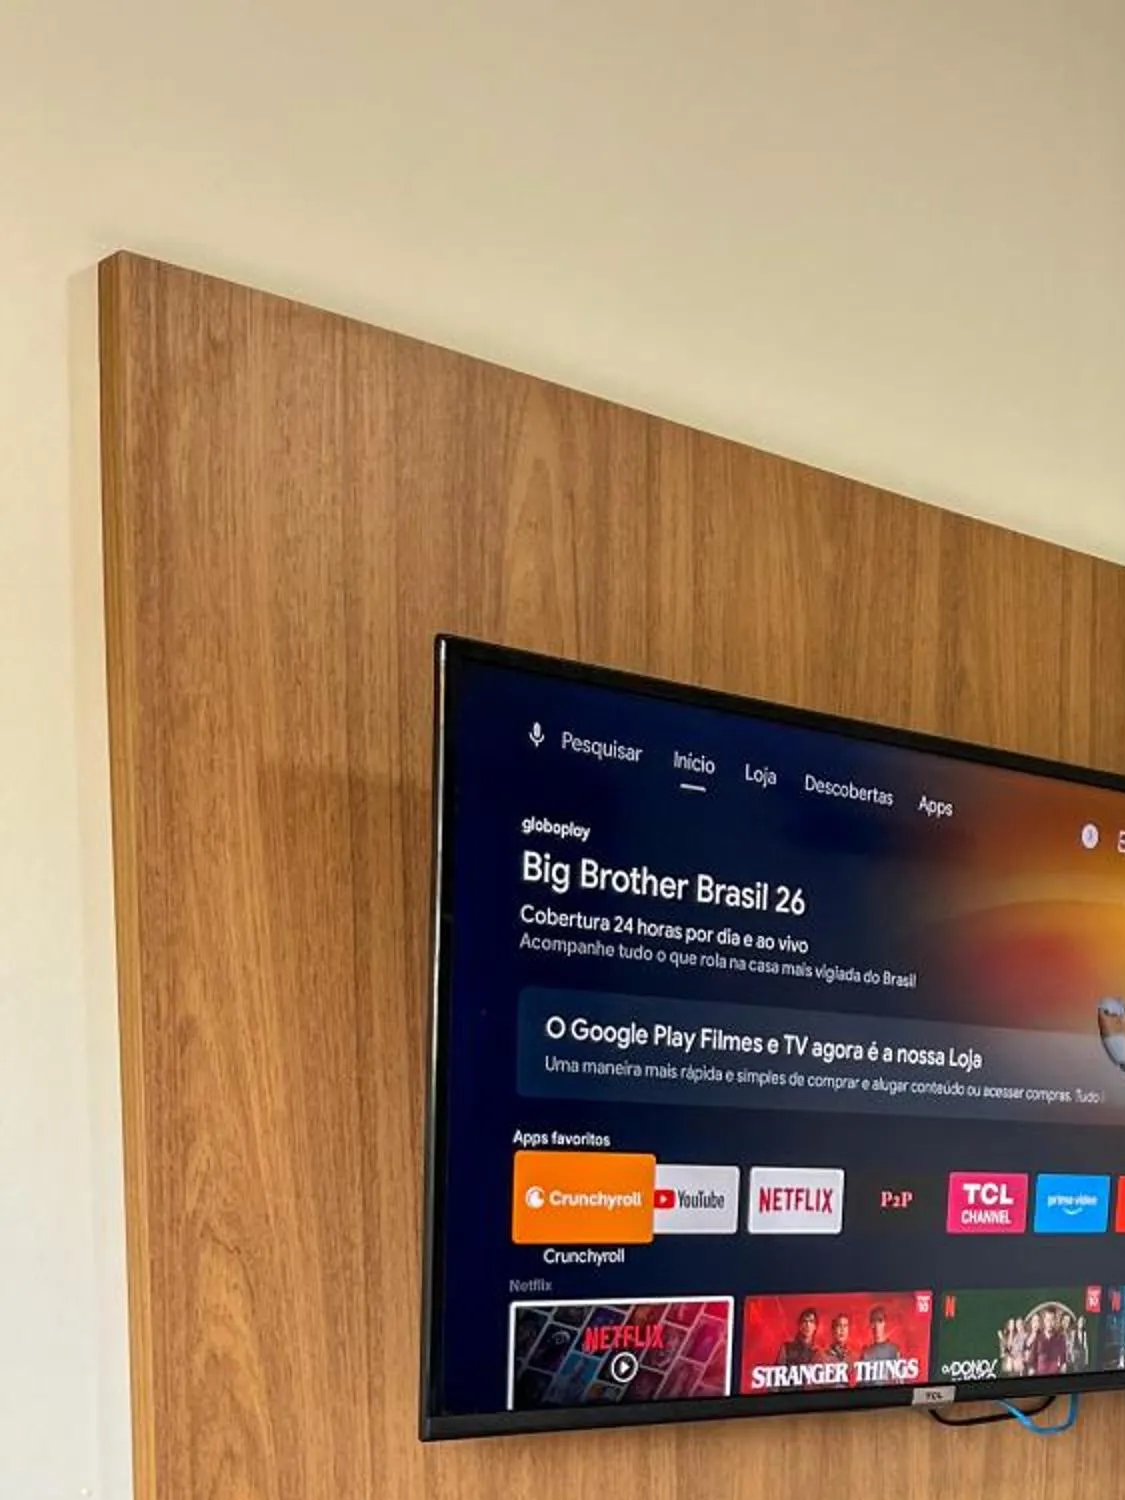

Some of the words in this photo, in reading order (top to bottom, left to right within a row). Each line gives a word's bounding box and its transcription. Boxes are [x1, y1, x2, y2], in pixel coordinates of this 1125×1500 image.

[561, 731, 643, 762] Pesquisar
[745, 763, 777, 788] Loja
[805, 774, 894, 806] Descobertas
[918, 795, 953, 818] Apps
[521, 816, 591, 843] globoplay
[523, 850, 571, 894] Big
[580, 857, 689, 901] Brother
[697, 873, 769, 911] Brasil
[775, 885, 806, 915] 26
[520, 904, 611, 932] Cobertura
[613, 915, 633, 934] 24
[637, 918, 683, 940] horas
[685, 927, 714, 945] por
[717, 927, 741, 946] dia
[743, 934, 753, 947] e
[756, 935, 775, 950] ao
[778, 935, 809, 954] vivo
[519, 932, 615, 957] Acompanhe
[619, 943, 653, 961] tudo
[656, 950, 667, 963] o
[669, 950, 697, 968] que
[700, 952, 727, 969] rola
[729, 958, 746, 971] na
[748, 960, 779, 974] casa
[782, 961, 813, 978] mais
[815, 963, 861, 983] vigiada
[863, 970, 880, 985] do
[883, 971, 917, 989] Brasil
[546, 1015, 566, 1039] O
[571, 1017, 648, 1049] Google
[653, 1024, 696, 1053] Play
[700, 1027, 763, 1054] Filmes
[767, 1039, 779, 1055] e
[783, 1034, 809, 1056] TV
[811, 1041, 864, 1063] agora
[867, 1041, 879, 1062] é
[882, 1048, 893, 1063] a
[897, 1048, 945, 1067] nossa
[949, 1047, 983, 1073] Loja
[545, 1055, 579, 1074] Uma
[582, 1059, 642, 1077] maneira
[645, 1061, 678, 1079] mais
[725, 1070, 734, 1083] e
[737, 1068, 786, 1087] simples
[788, 1072, 804, 1087] de
[807, 1074, 860, 1091] comprar
[861, 1079, 869, 1090] e
[871, 1077, 909, 1095] alugar
[967, 1085, 980, 1097] ou
[983, 1086, 1024, 1100] acessar
[512, 1129, 548, 1147] Apps
[551, 1130, 611, 1147] favoritos
[549, 1190, 642, 1210] Crunchyroll
[677, 1190, 725, 1209] YouTube
[758, 1186, 833, 1214] NETFLIX
[962, 1183, 1014, 1205] TCL
[960, 1209, 1011, 1225] CHANNEL
[543, 1248, 625, 1266] Crunchyroll
[509, 1278, 552, 1293] Netflix
[583, 1324, 665, 1353] NETFLIX
[751, 1362, 849, 1389] STRANGER
[853, 1358, 920, 1382] THINGS
